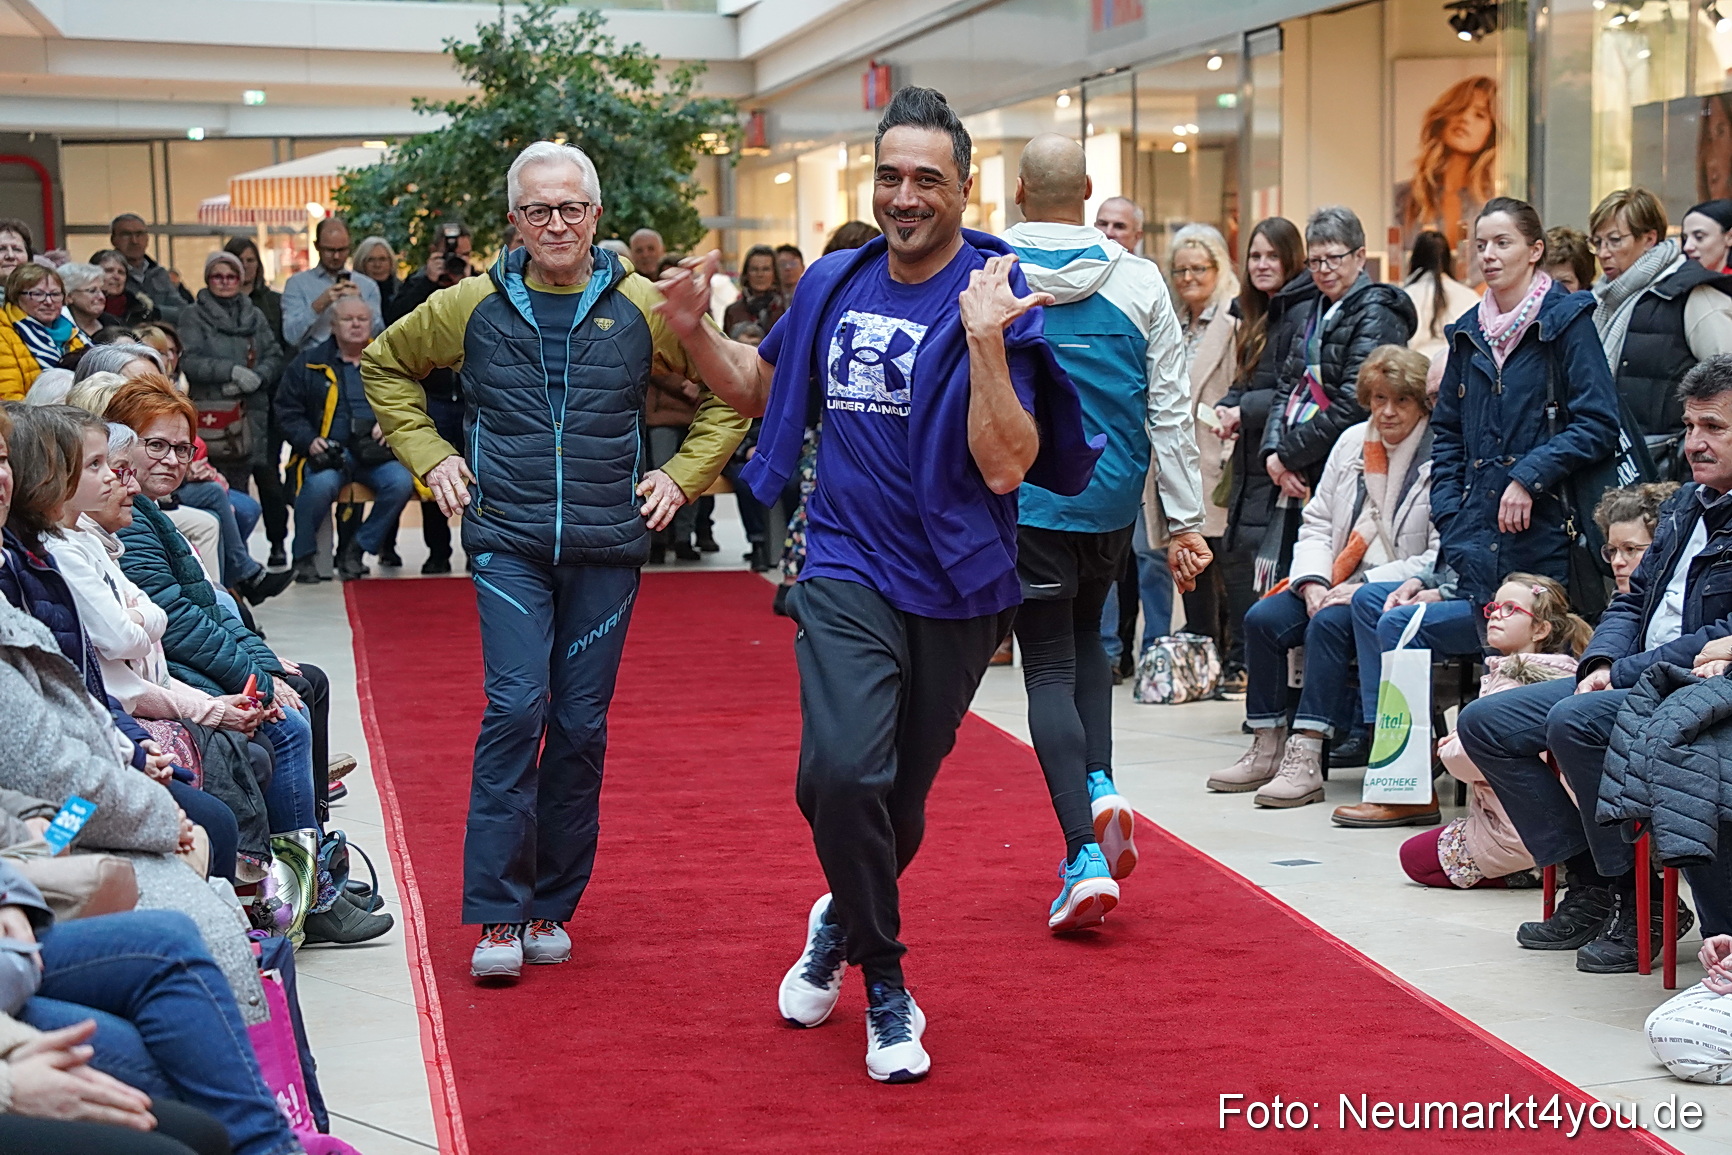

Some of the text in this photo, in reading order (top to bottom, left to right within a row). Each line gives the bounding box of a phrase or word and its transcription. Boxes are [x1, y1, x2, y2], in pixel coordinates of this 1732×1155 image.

[826, 399, 865, 413] UNDER
[566, 588, 636, 660] DYNAFIT
[1370, 777, 1418, 787] APOTHEKE
